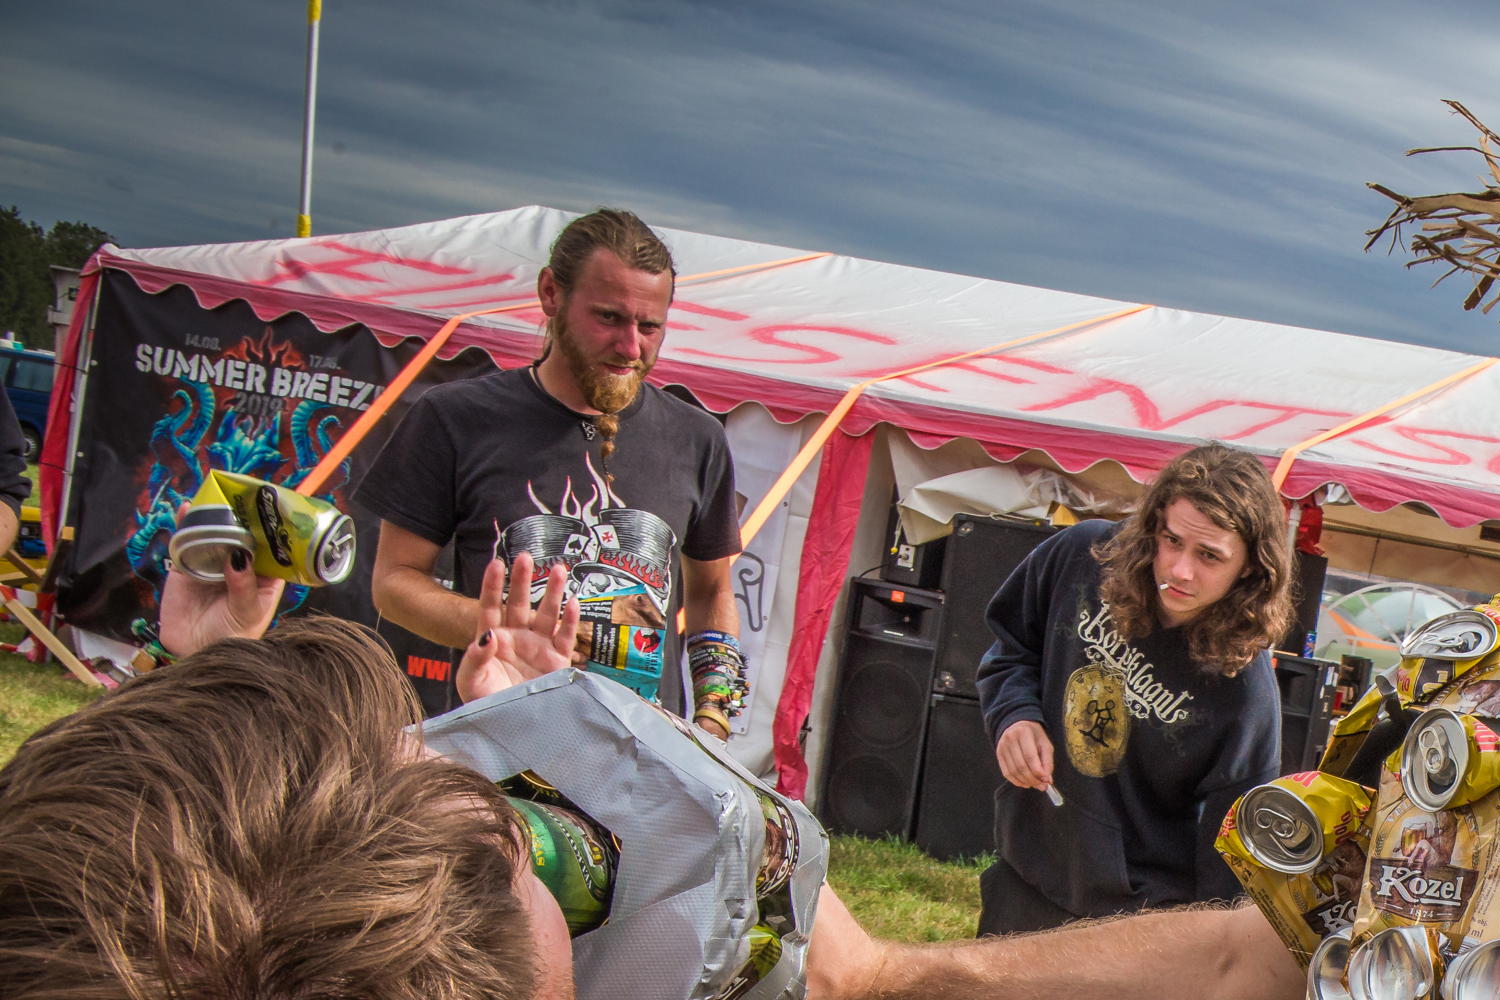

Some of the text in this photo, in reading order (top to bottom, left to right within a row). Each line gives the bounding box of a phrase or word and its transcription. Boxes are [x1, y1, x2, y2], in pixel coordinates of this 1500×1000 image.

[136, 343, 386, 411] SUMMER BREEZ
[234, 393, 284, 418] 2019
[1377, 865, 1463, 903] Kozel
[1409, 908, 1434, 919] 1874
